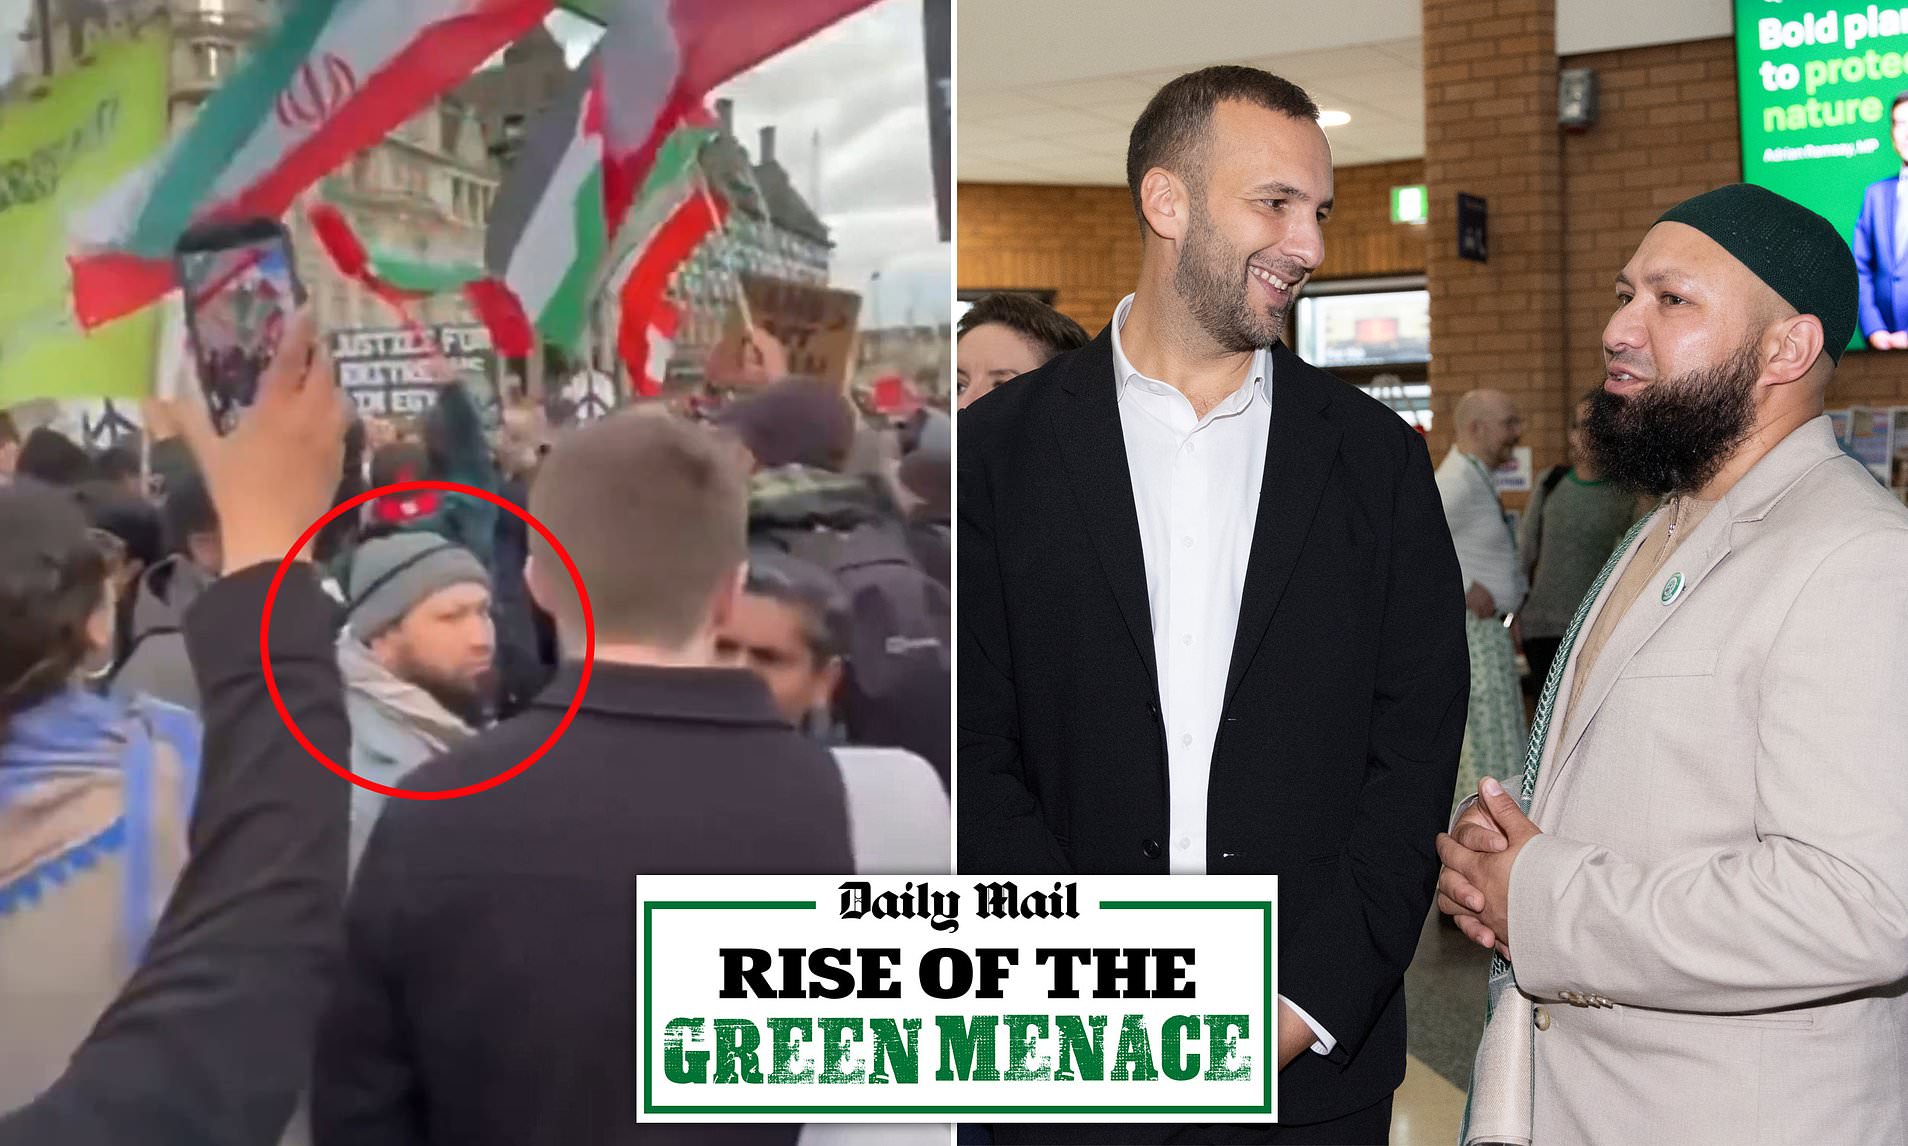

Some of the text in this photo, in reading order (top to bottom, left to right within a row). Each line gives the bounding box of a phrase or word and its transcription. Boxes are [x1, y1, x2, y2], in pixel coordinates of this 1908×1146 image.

[1758, 10, 1838, 50] Bold
[1758, 49, 1908, 95] to prote
[1763, 96, 1883, 132] nature
